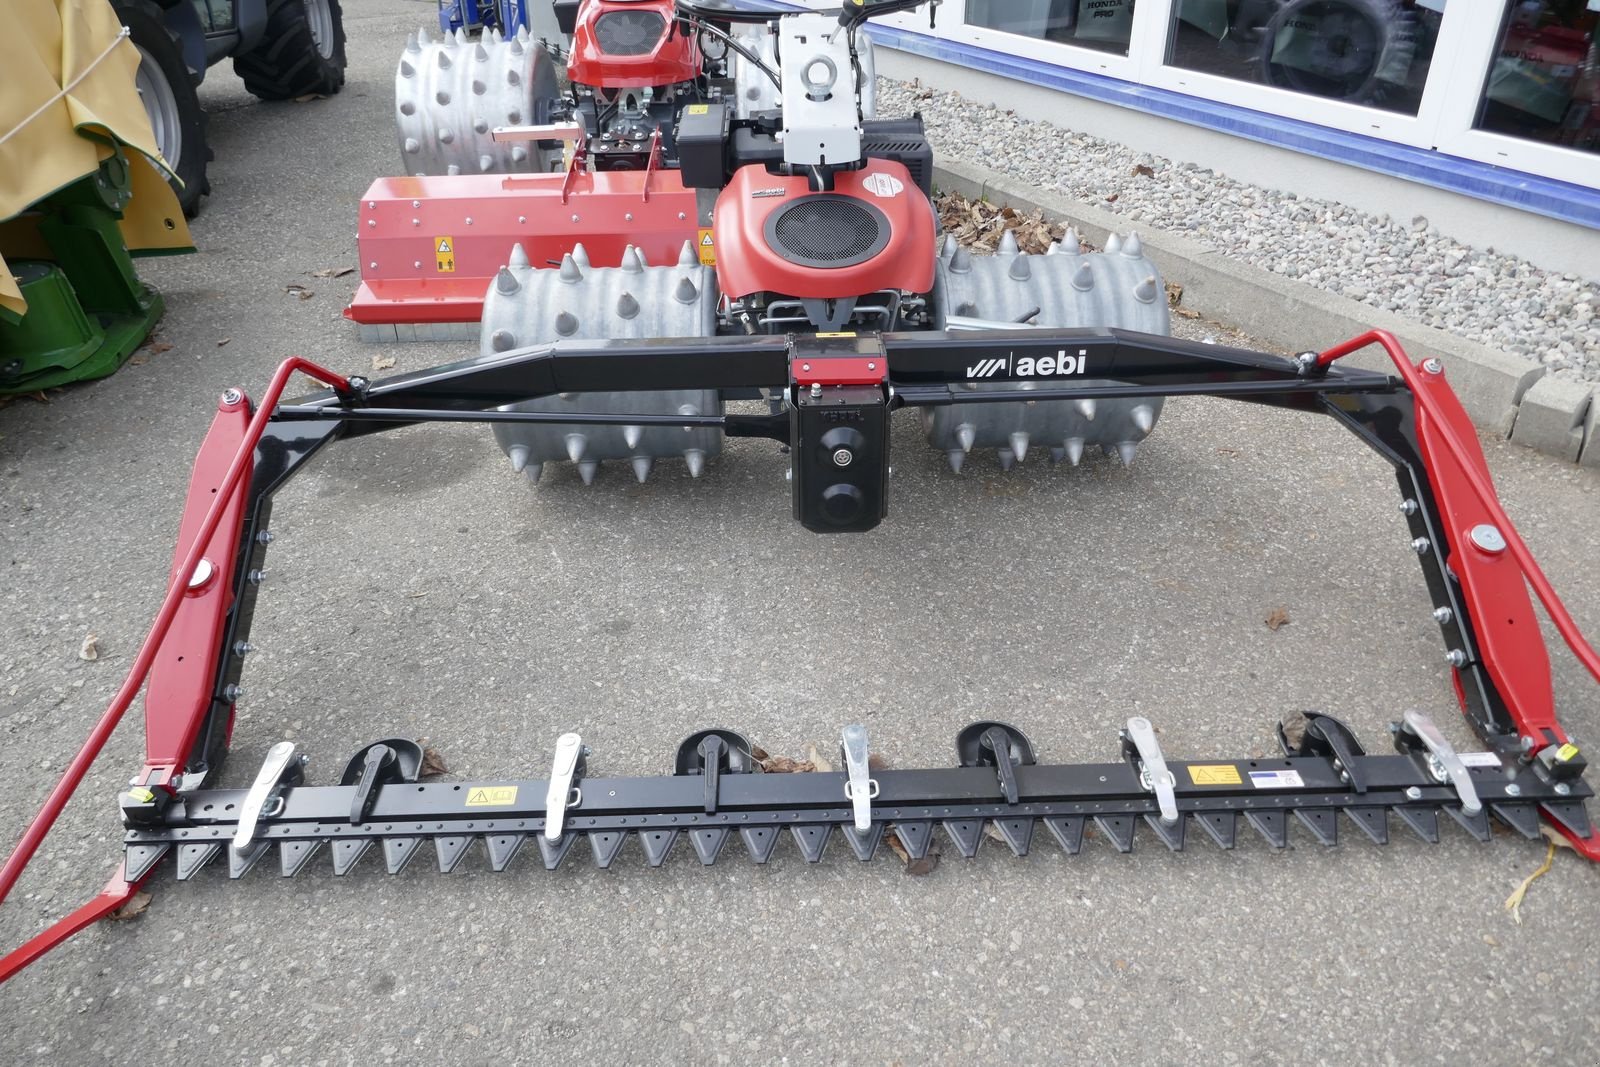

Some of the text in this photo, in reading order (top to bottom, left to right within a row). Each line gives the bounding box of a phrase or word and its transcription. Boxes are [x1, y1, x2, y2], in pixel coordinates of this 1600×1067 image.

[1088, 0, 1122, 9] HONDA
[1094, 10, 1114, 18] PRO
[1016, 349, 1087, 377] aebi
